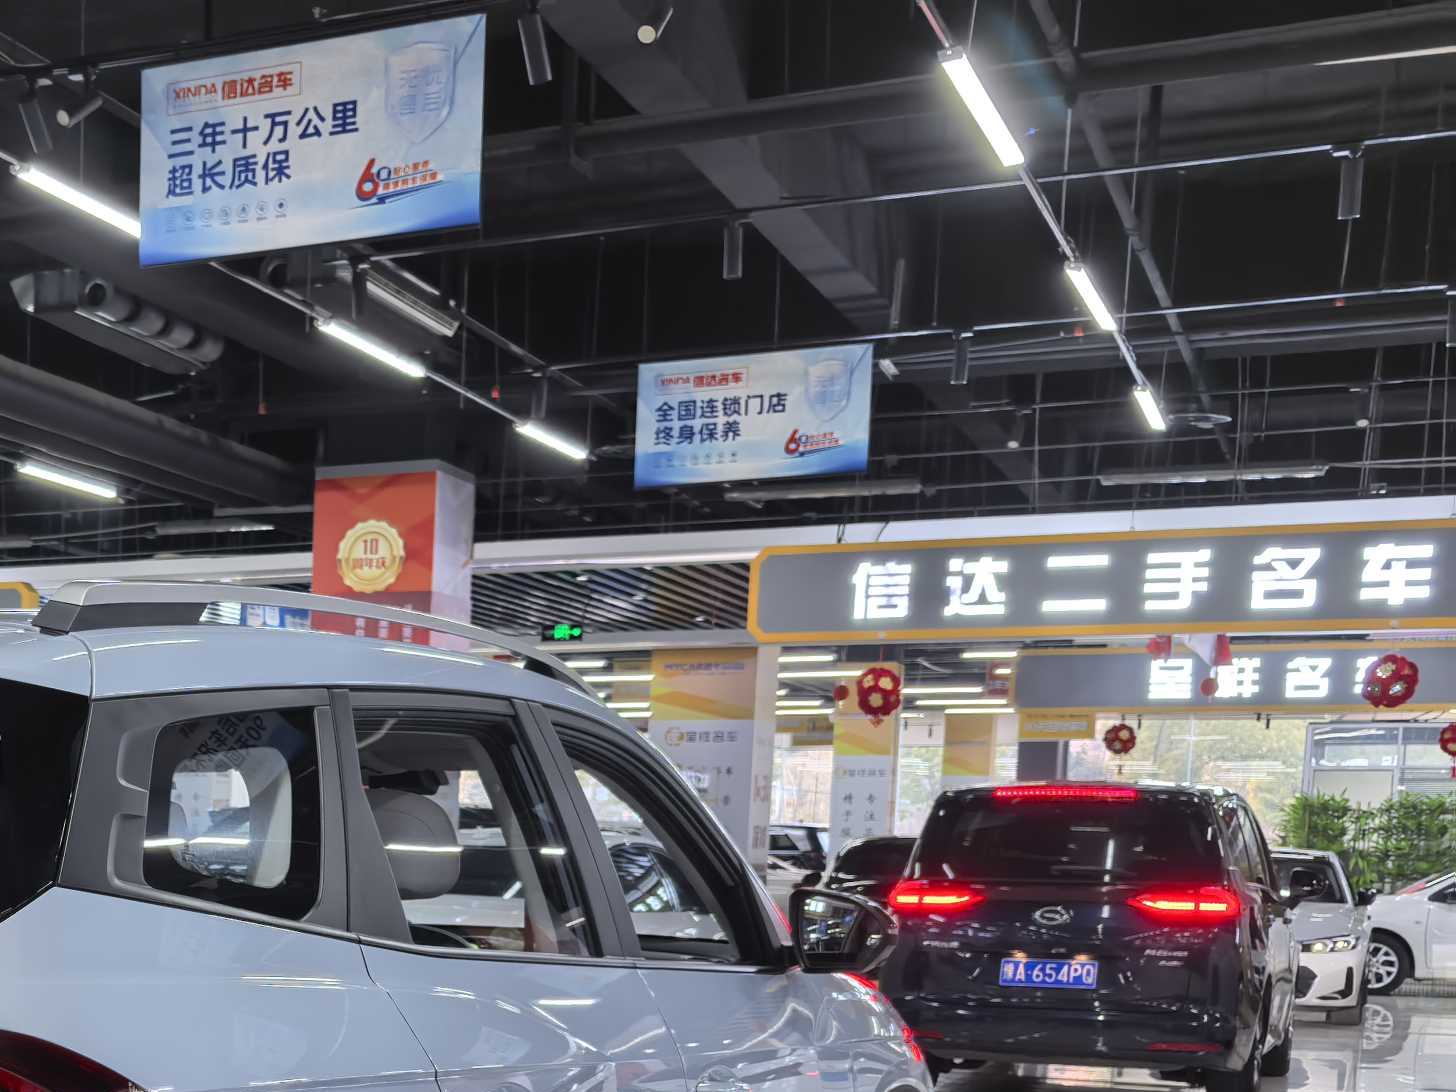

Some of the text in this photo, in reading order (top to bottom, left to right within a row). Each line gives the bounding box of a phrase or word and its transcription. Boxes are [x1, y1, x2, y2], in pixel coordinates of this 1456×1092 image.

[222, 71, 294, 101] 信达名车
[167, 100, 359, 159] 三年十万公里
[165, 150, 291, 200] 超长质保
[654, 393, 789, 423] 全国连锁门店
[654, 421, 741, 446] 终身保养
[852, 542, 1434, 621] 信达二手名车
